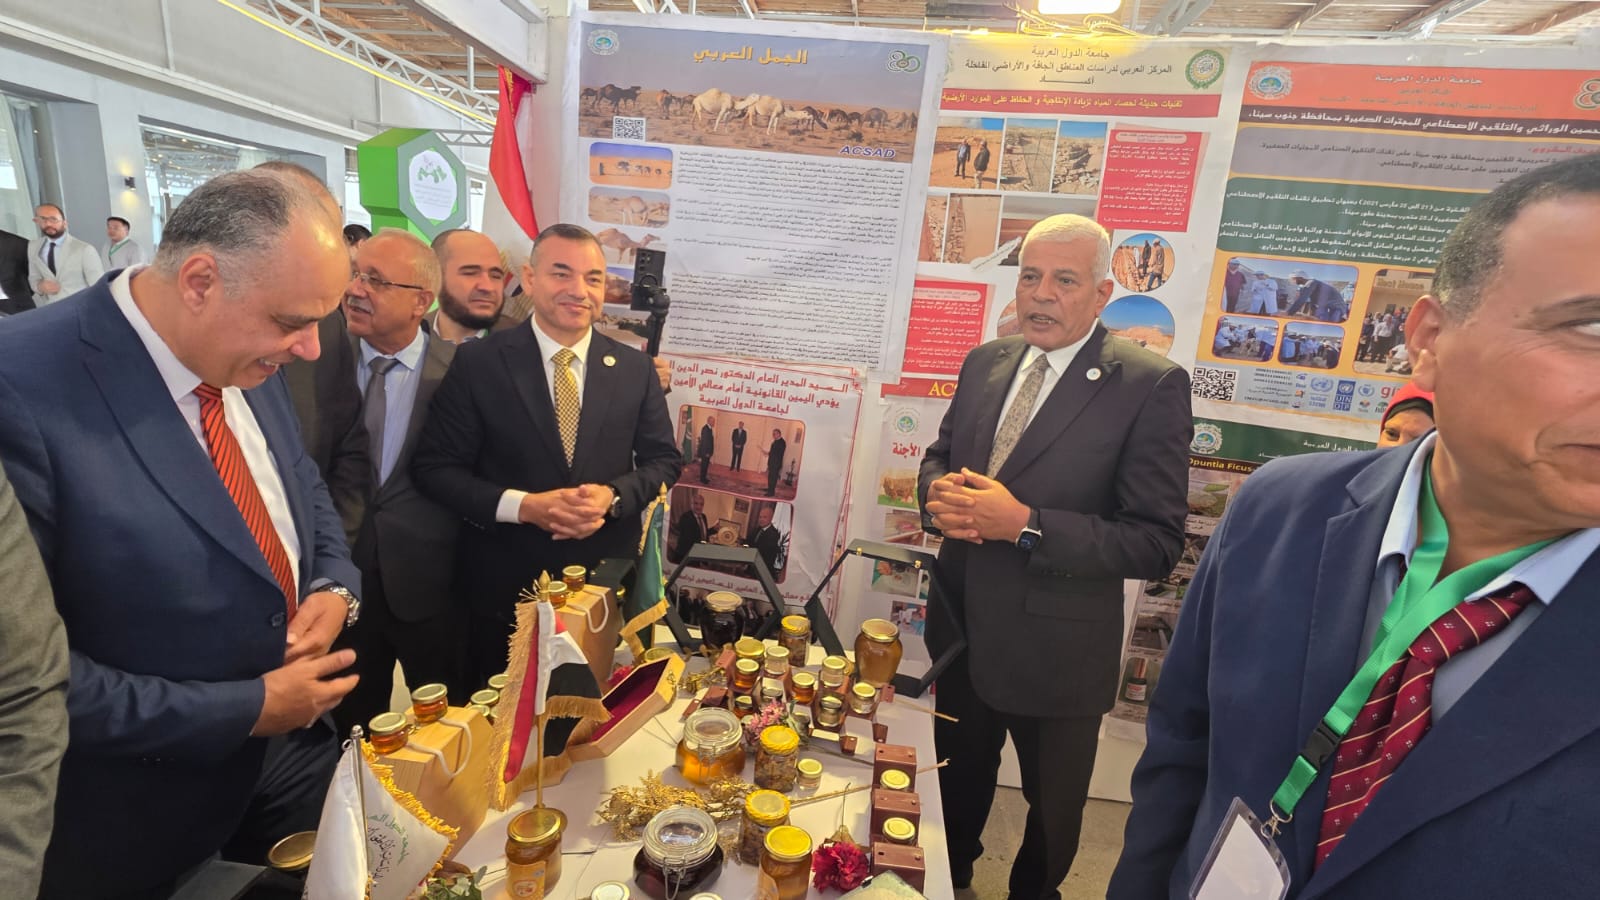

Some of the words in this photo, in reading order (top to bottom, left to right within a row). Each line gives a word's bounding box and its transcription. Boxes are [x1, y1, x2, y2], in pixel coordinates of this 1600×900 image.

[693, 45, 754, 64] العربي
[758, 47, 809, 66] الجمل
[1030, 46, 1059, 57] العربية
[1061, 48, 1083, 58] الدول
[1085, 48, 1110, 59] جامعة
[1031, 60, 1054, 71] الجافة
[1055, 63, 1084, 72] المناطق
[1085, 64, 1119, 73] لدراسات
[1119, 65, 1144, 75] العربي
[1146, 65, 1172, 74] المركز
[1375, 72, 1414, 83] العربية
[1415, 74, 1446, 83] الدول
[1448, 75, 1482, 86] جامعة
[992, 96, 1008, 104] على
[1009, 96, 1032, 104] الحفاظ
[1137, 98, 1158, 107] حديثة
[1299, 113, 1342, 121] بمحافظة
[1424, 120, 1477, 130] الاصطناعي
[1479, 123, 1523, 132] والتلقيح
[1526, 124, 1569, 134] الوراثي
[1570, 125, 1600, 137] حسين
[839, 145, 897, 160] ACSAD
[1433, 203, 1445, 212] من
[677, 360, 699, 374] الدين
[701, 365, 718, 376] نصر
[720, 367, 755, 381] الدكتور
[756, 373, 780, 383] العام
[673, 375, 697, 387] الأمين
[698, 380, 724, 391] معالي
[781, 378, 807, 387] المدير
[725, 382, 744, 392] أمام
[807, 382, 849, 394] السيد
[928, 381, 957, 397] AC
[746, 387, 786, 398] القانونية
[699, 395, 730, 405] العربية
[731, 398, 756, 409] الدول
[788, 394, 815, 403] اليمين
[816, 398, 840, 408] يؤدي
[757, 403, 790, 415] لجامعة
